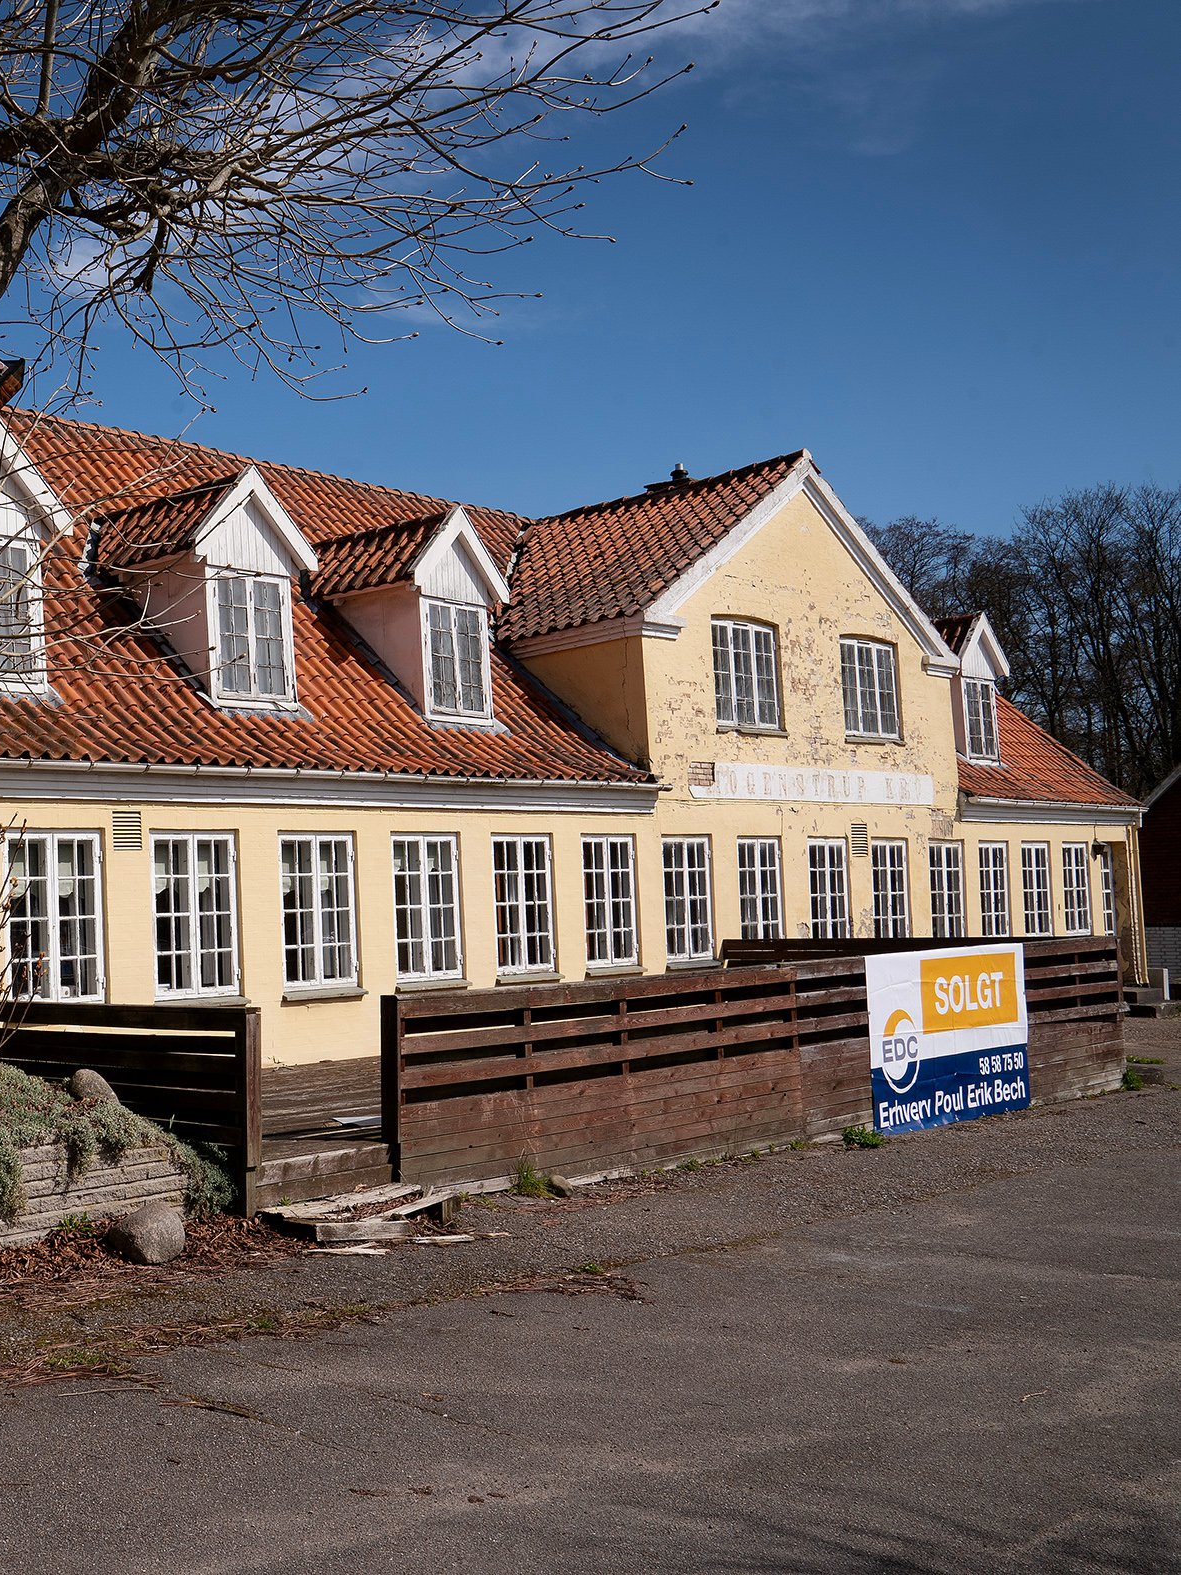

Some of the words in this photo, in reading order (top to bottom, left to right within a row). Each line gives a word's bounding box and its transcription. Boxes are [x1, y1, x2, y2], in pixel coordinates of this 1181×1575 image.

[934, 971, 1004, 1016] SOLGT
[882, 1035, 918, 1064] EDC
[978, 1057, 990, 1076] 58
[991, 1055, 1002, 1074] 58
[1002, 1053, 1013, 1072] 75
[1013, 1051, 1024, 1070] 50
[878, 1098, 931, 1129] Erhverv
[934, 1086, 964, 1116] Poul
[967, 1081, 993, 1108] Erik
[994, 1076, 1026, 1103] Bech
